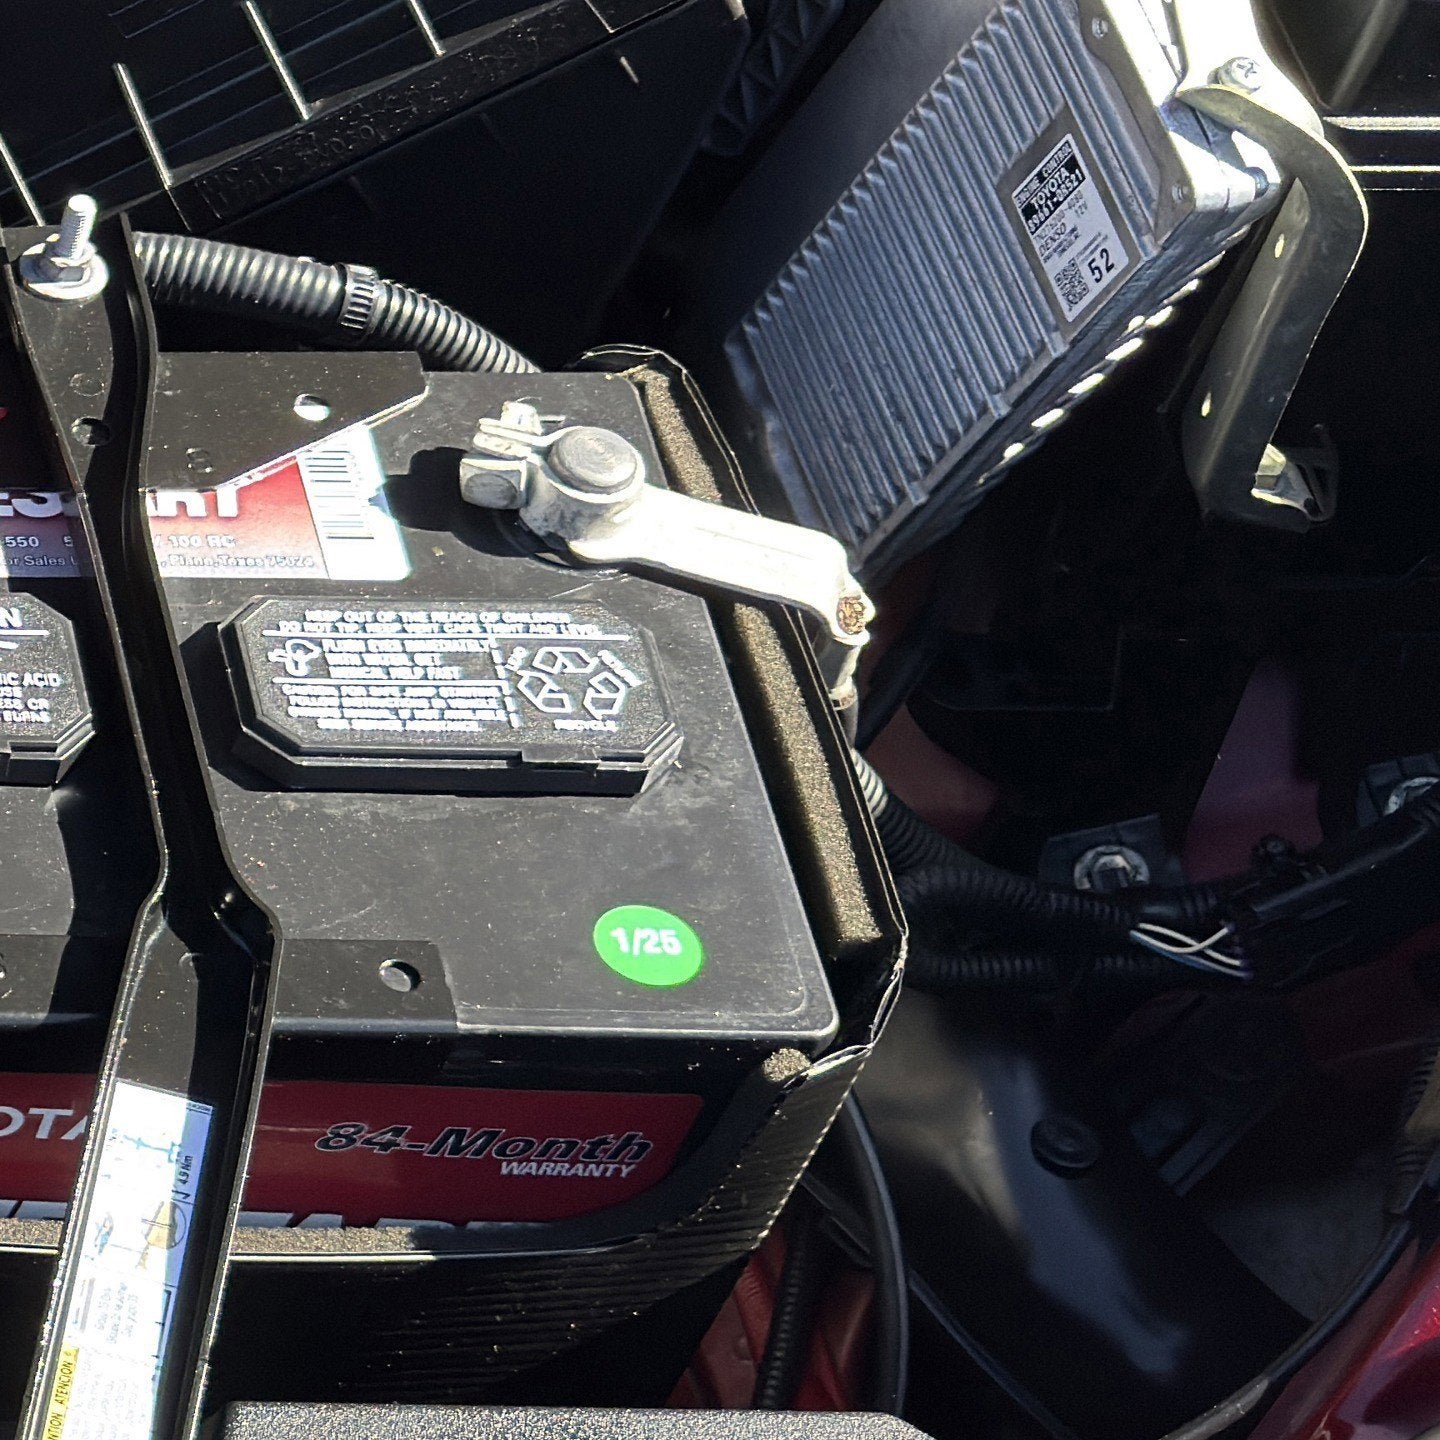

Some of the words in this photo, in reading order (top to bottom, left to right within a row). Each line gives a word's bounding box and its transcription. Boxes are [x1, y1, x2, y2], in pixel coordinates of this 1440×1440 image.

[1030, 166, 1071, 210] TOYOTA
[1087, 247, 1115, 284] 52
[25, 553, 66, 567] Sales
[21, 672, 62, 688] ACID
[426, 666, 463, 680] FAST
[610, 926, 683, 957] 1/25
[314, 1121, 654, 1163] 84-Month
[499, 1160, 637, 1179] WARRANTY
